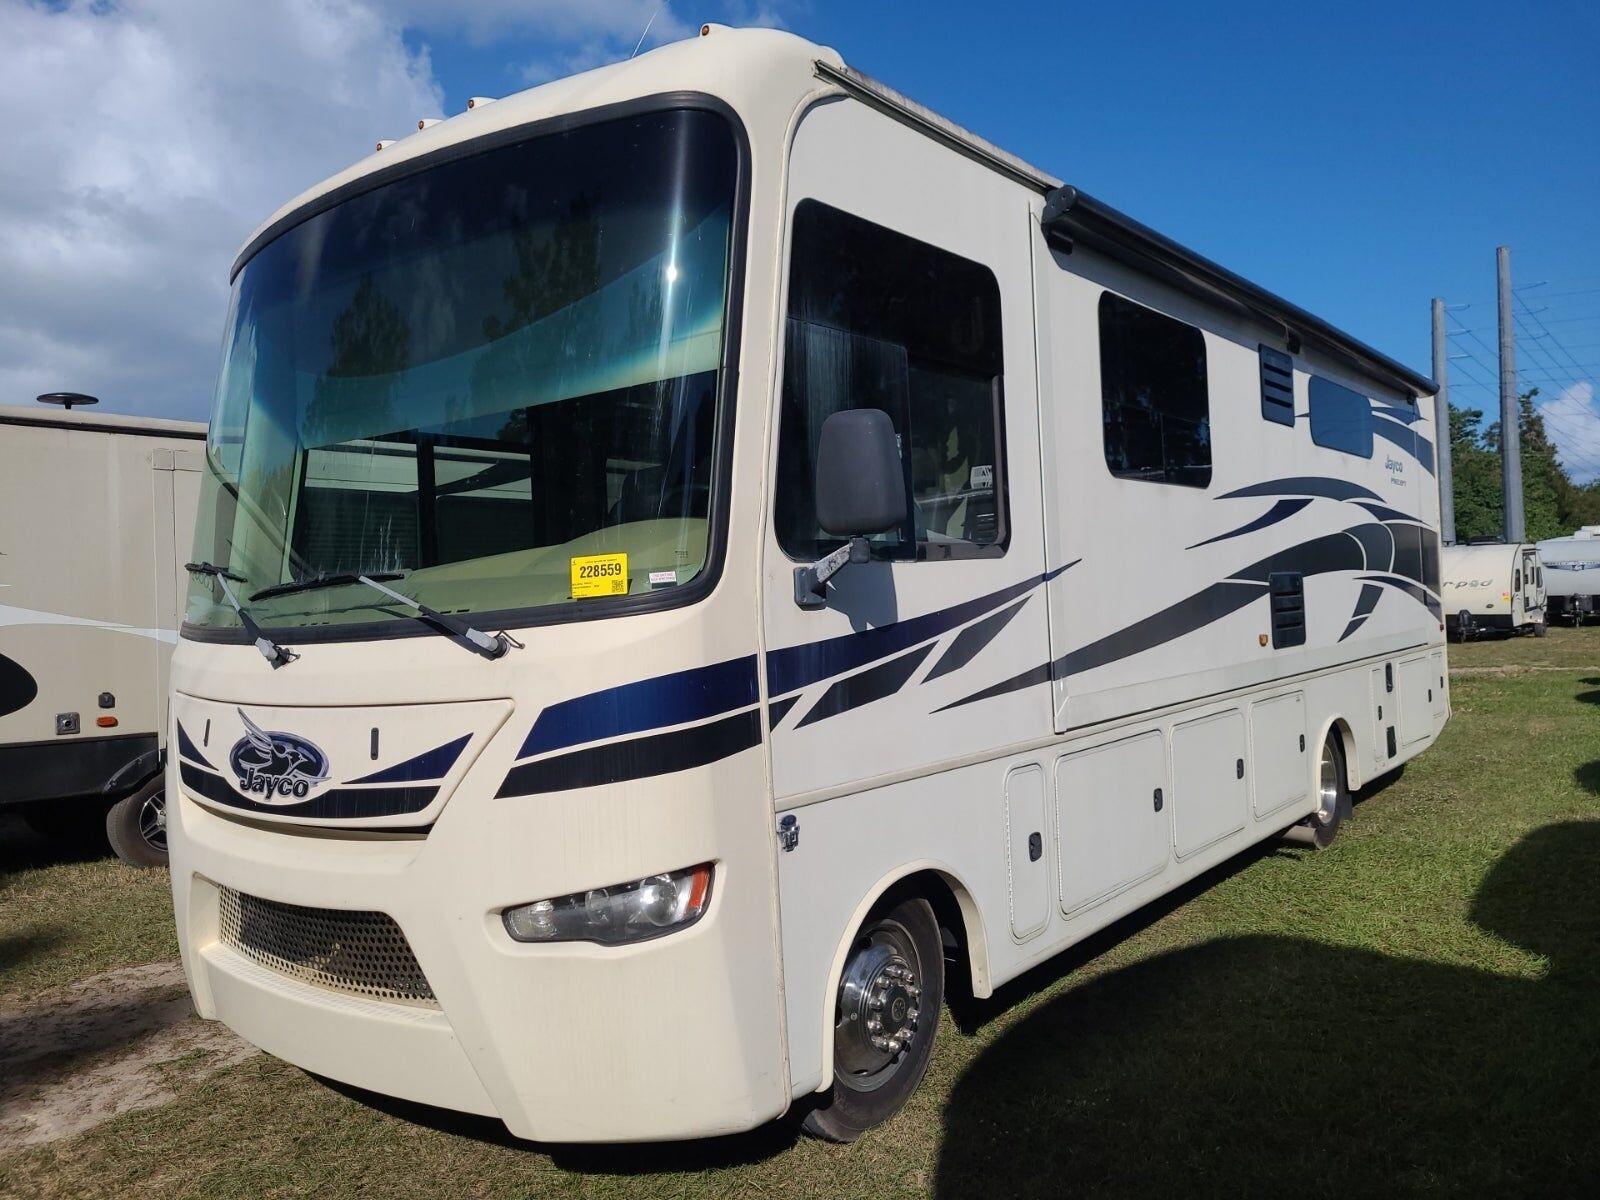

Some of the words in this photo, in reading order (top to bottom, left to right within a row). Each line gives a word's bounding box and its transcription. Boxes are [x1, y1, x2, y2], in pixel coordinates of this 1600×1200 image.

[1385, 454, 1403, 474] Jayco
[579, 562, 622, 579] 228559
[239, 767, 309, 800] Jayco
